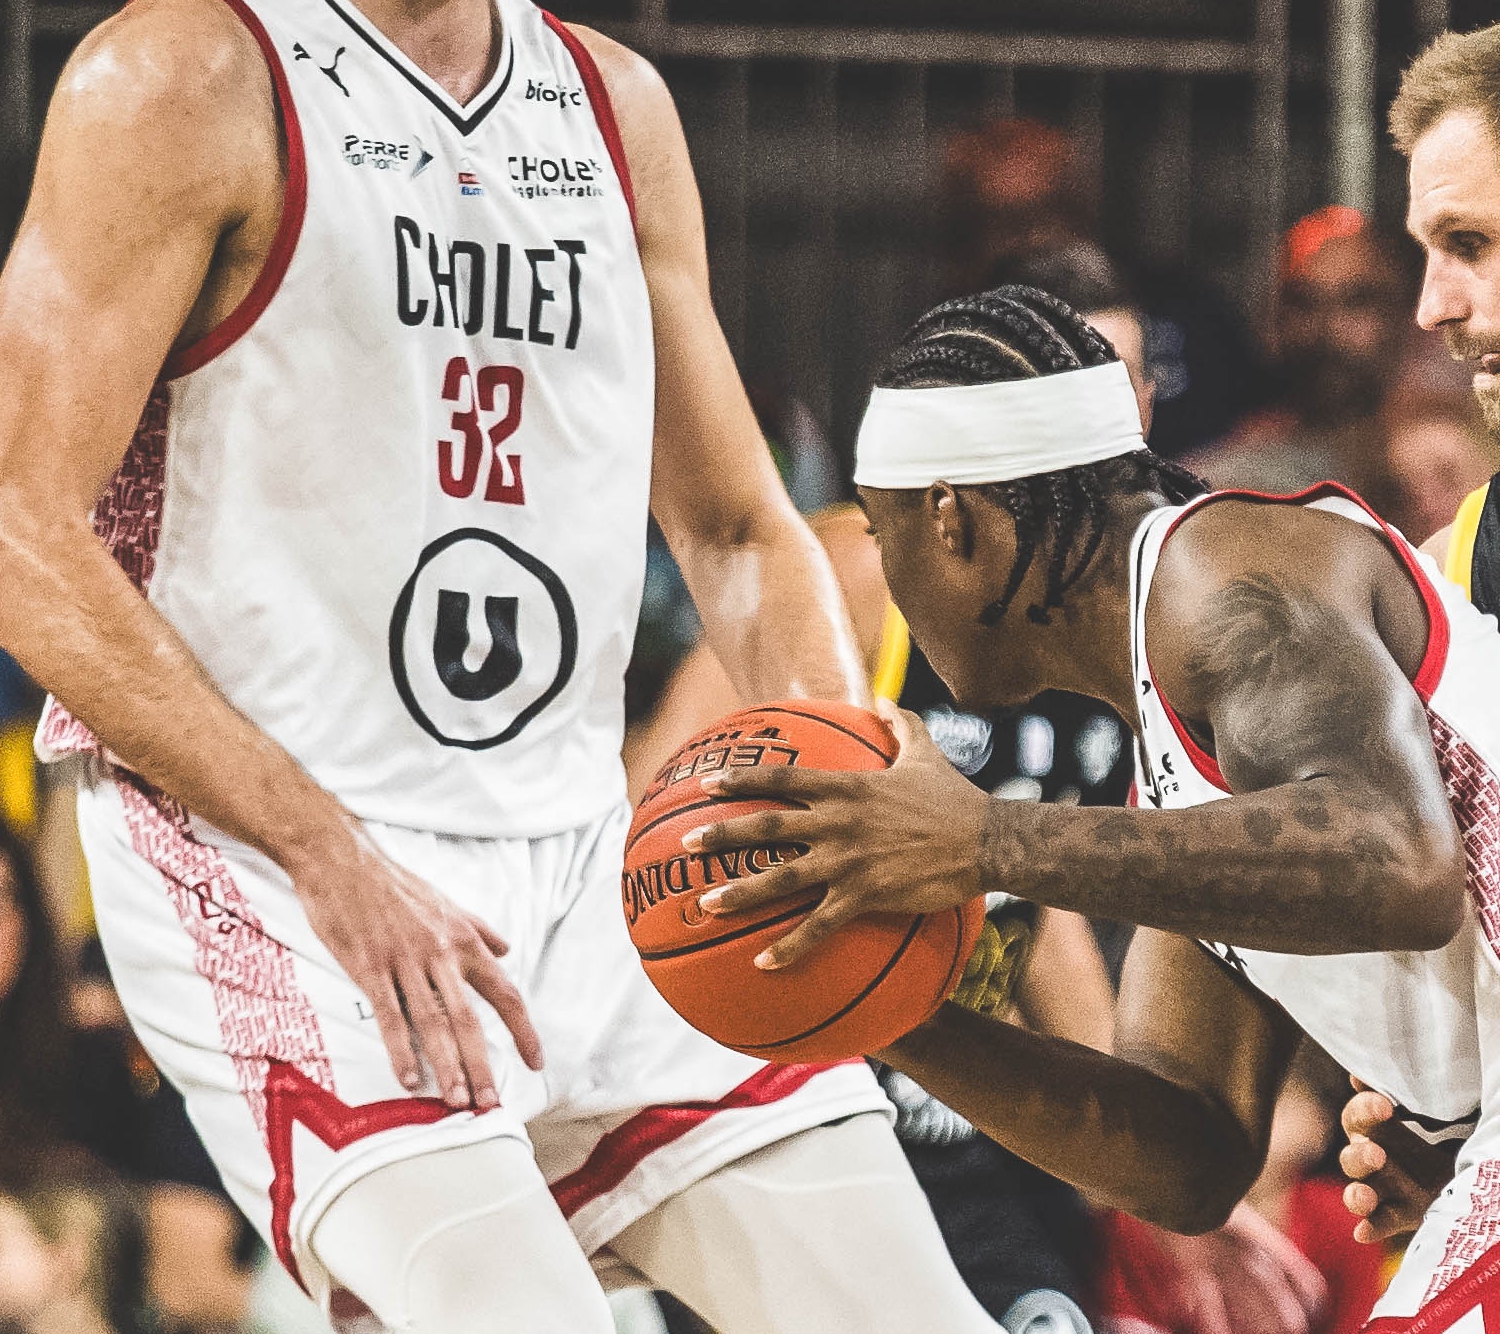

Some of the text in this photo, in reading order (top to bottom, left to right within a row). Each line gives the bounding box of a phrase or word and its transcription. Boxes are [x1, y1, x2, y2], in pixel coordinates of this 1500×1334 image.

[393, 215, 586, 349] CHOLET
[438, 357, 525, 505] 32
[433, 589, 523, 700] U
